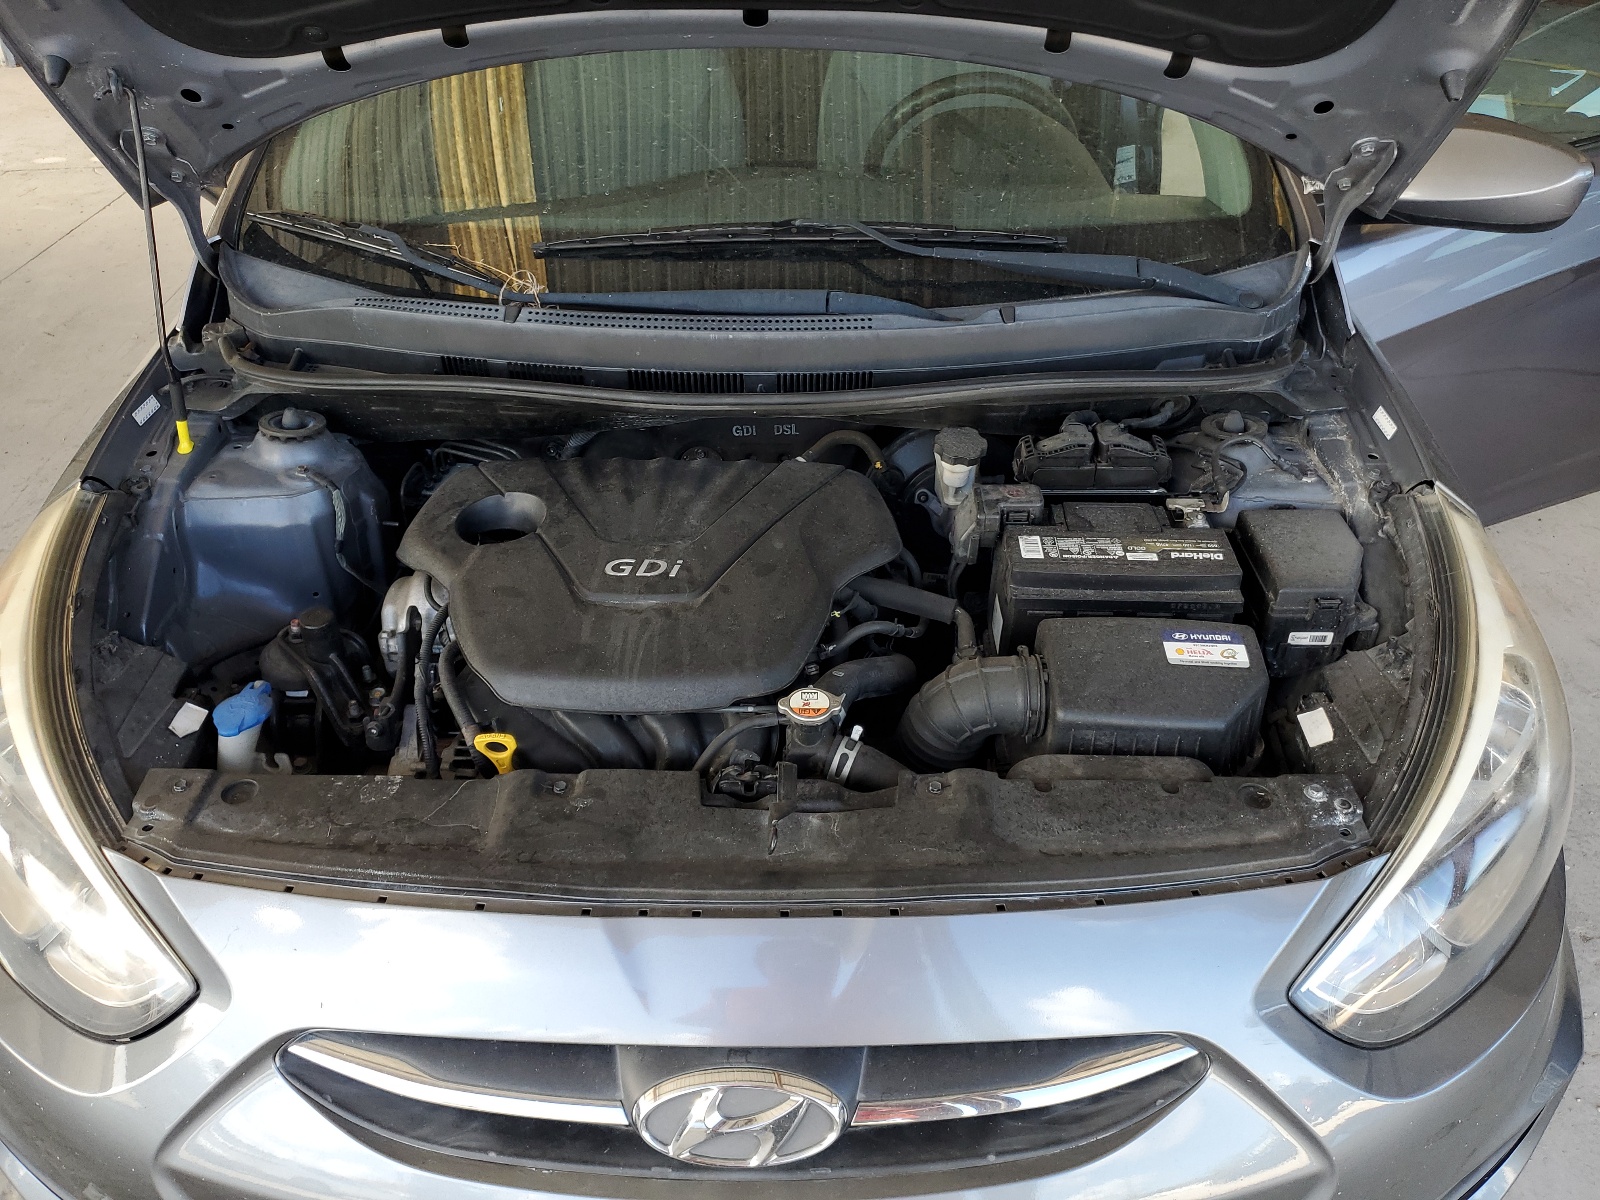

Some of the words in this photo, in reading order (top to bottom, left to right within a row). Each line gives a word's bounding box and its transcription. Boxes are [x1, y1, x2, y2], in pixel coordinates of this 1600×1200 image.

[732, 425, 757, 437] GDI
[774, 423, 800, 436] DSL
[1170, 551, 1224, 560] DieHard
[604, 558, 684, 577] GDi
[1190, 633, 1231, 641] HYUNDAI
